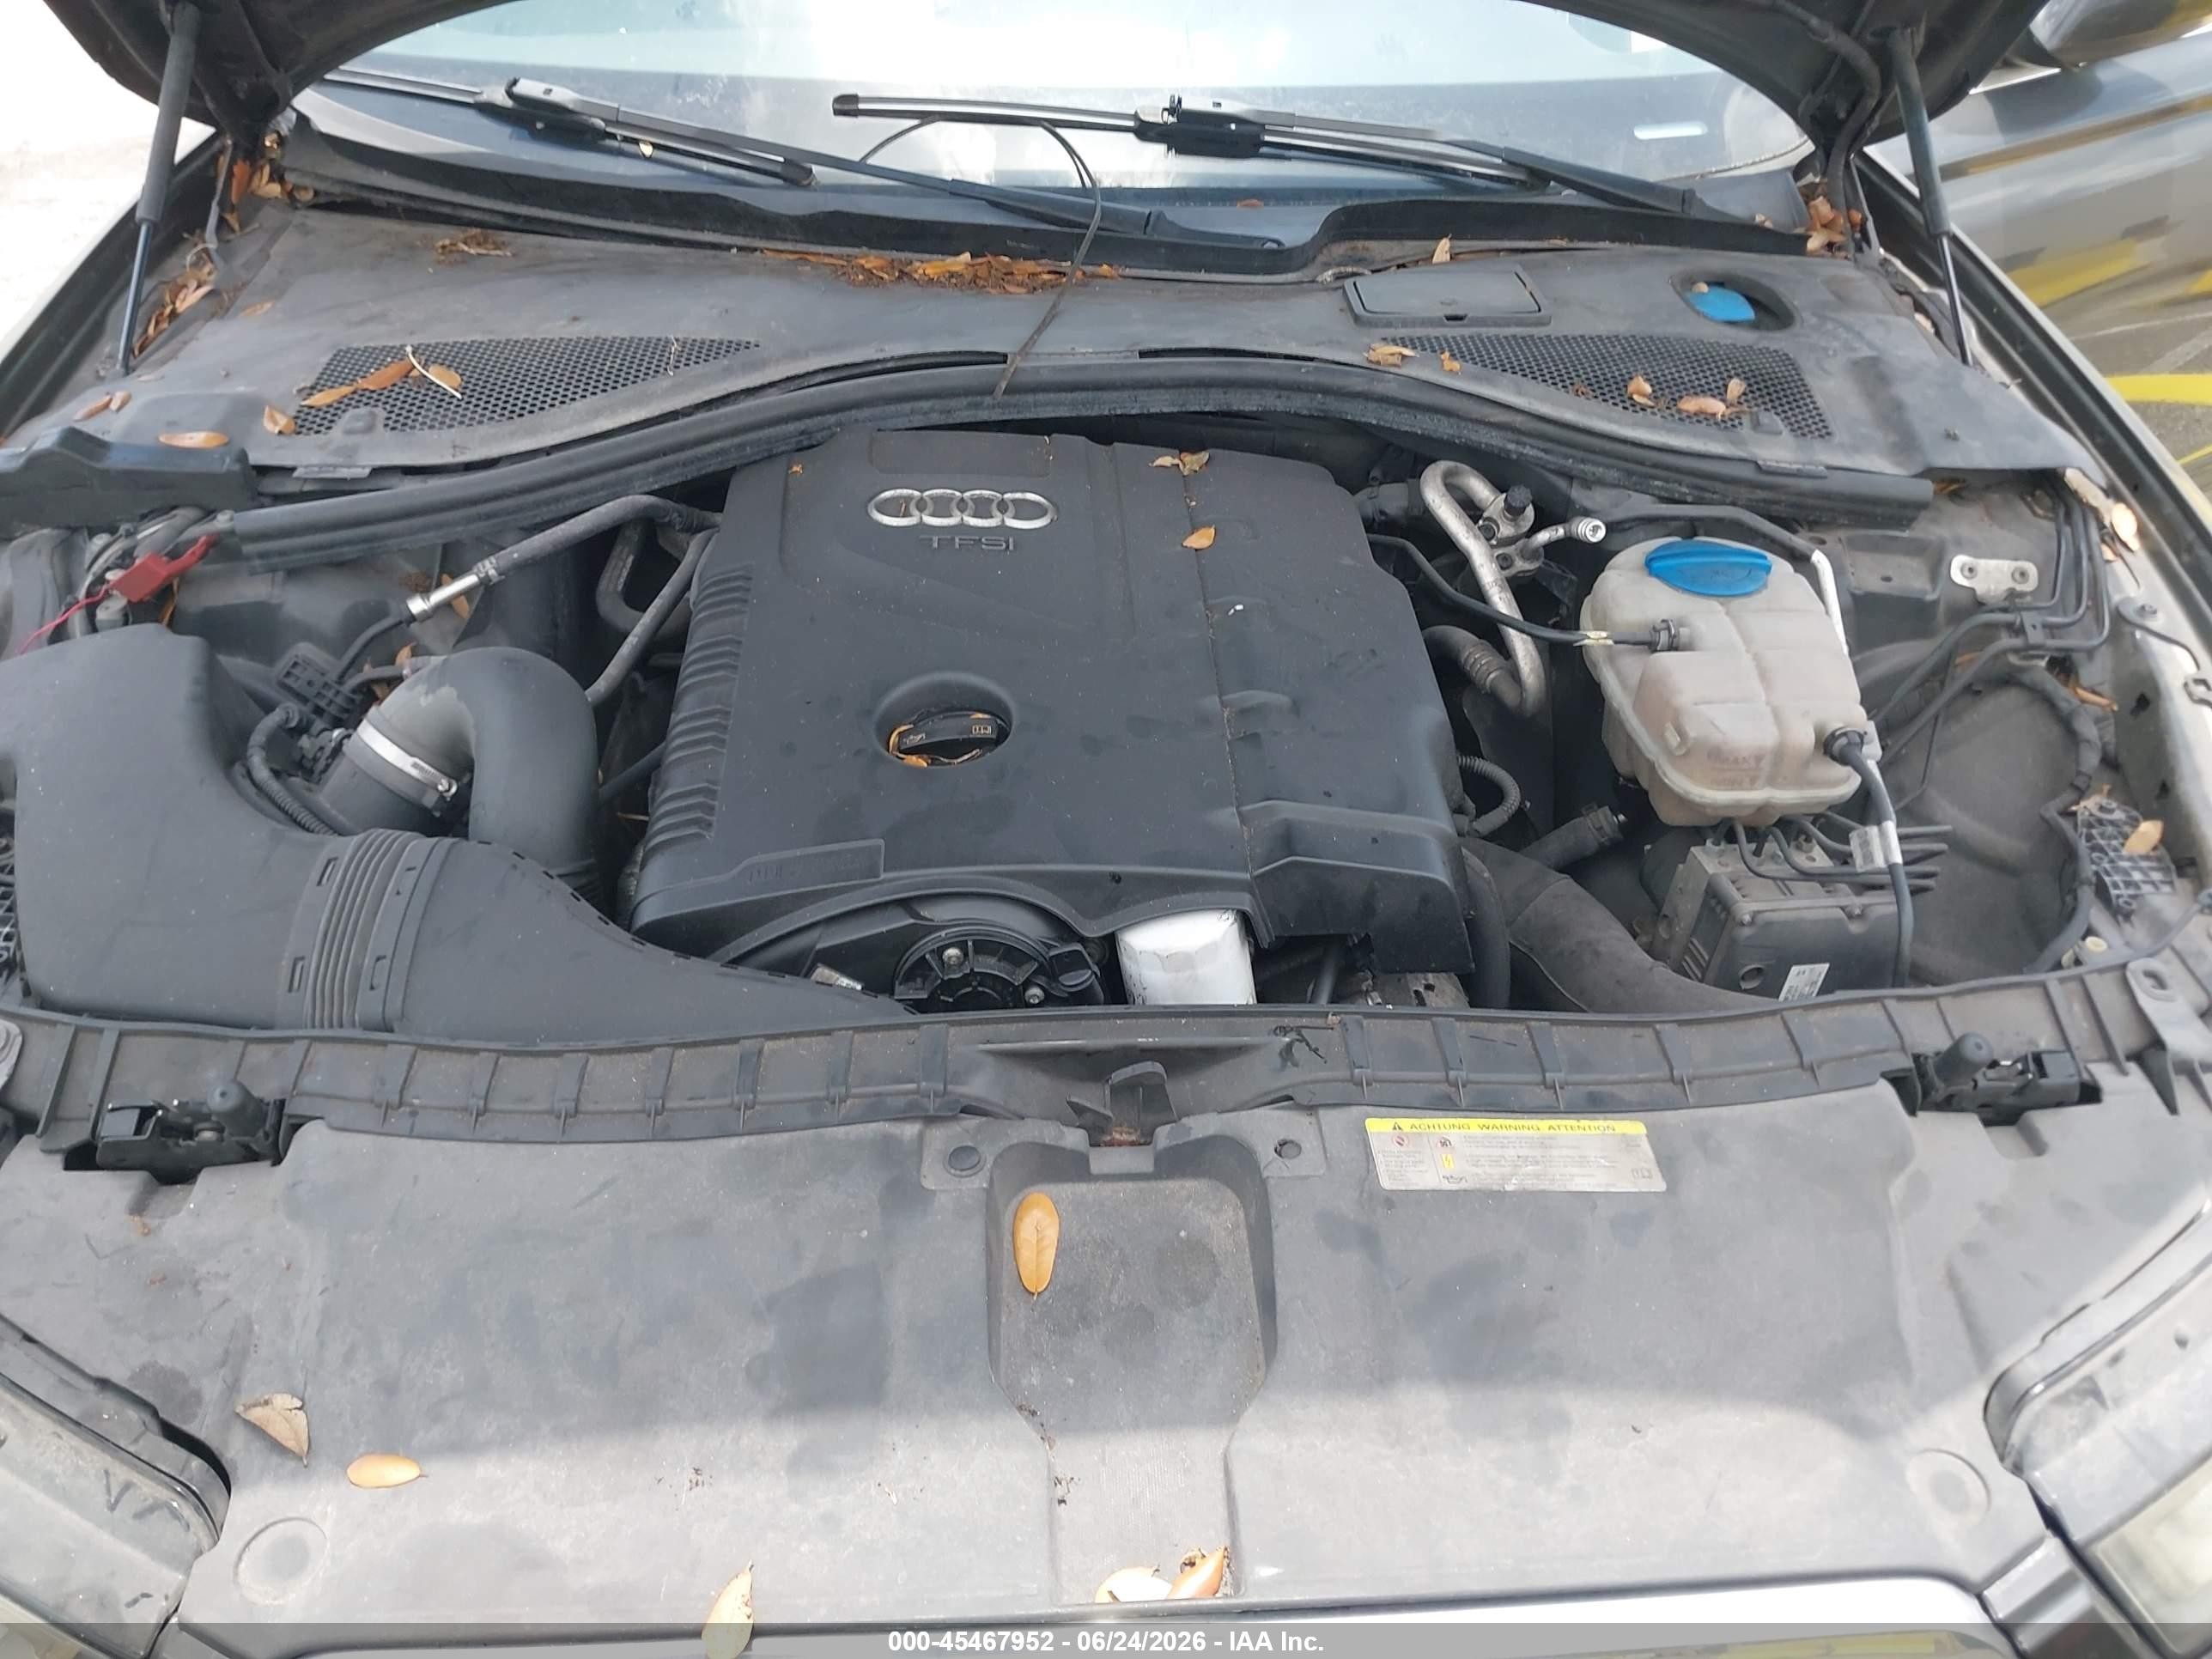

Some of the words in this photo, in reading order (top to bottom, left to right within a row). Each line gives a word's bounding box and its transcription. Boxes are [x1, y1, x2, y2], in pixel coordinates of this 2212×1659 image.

[920, 535, 1014, 550] TFSI
[1410, 1122, 1471, 1132] ACHTUNG
[1478, 1122, 1540, 1132] WARNING
[1548, 1123, 1616, 1133] ATTENTION
